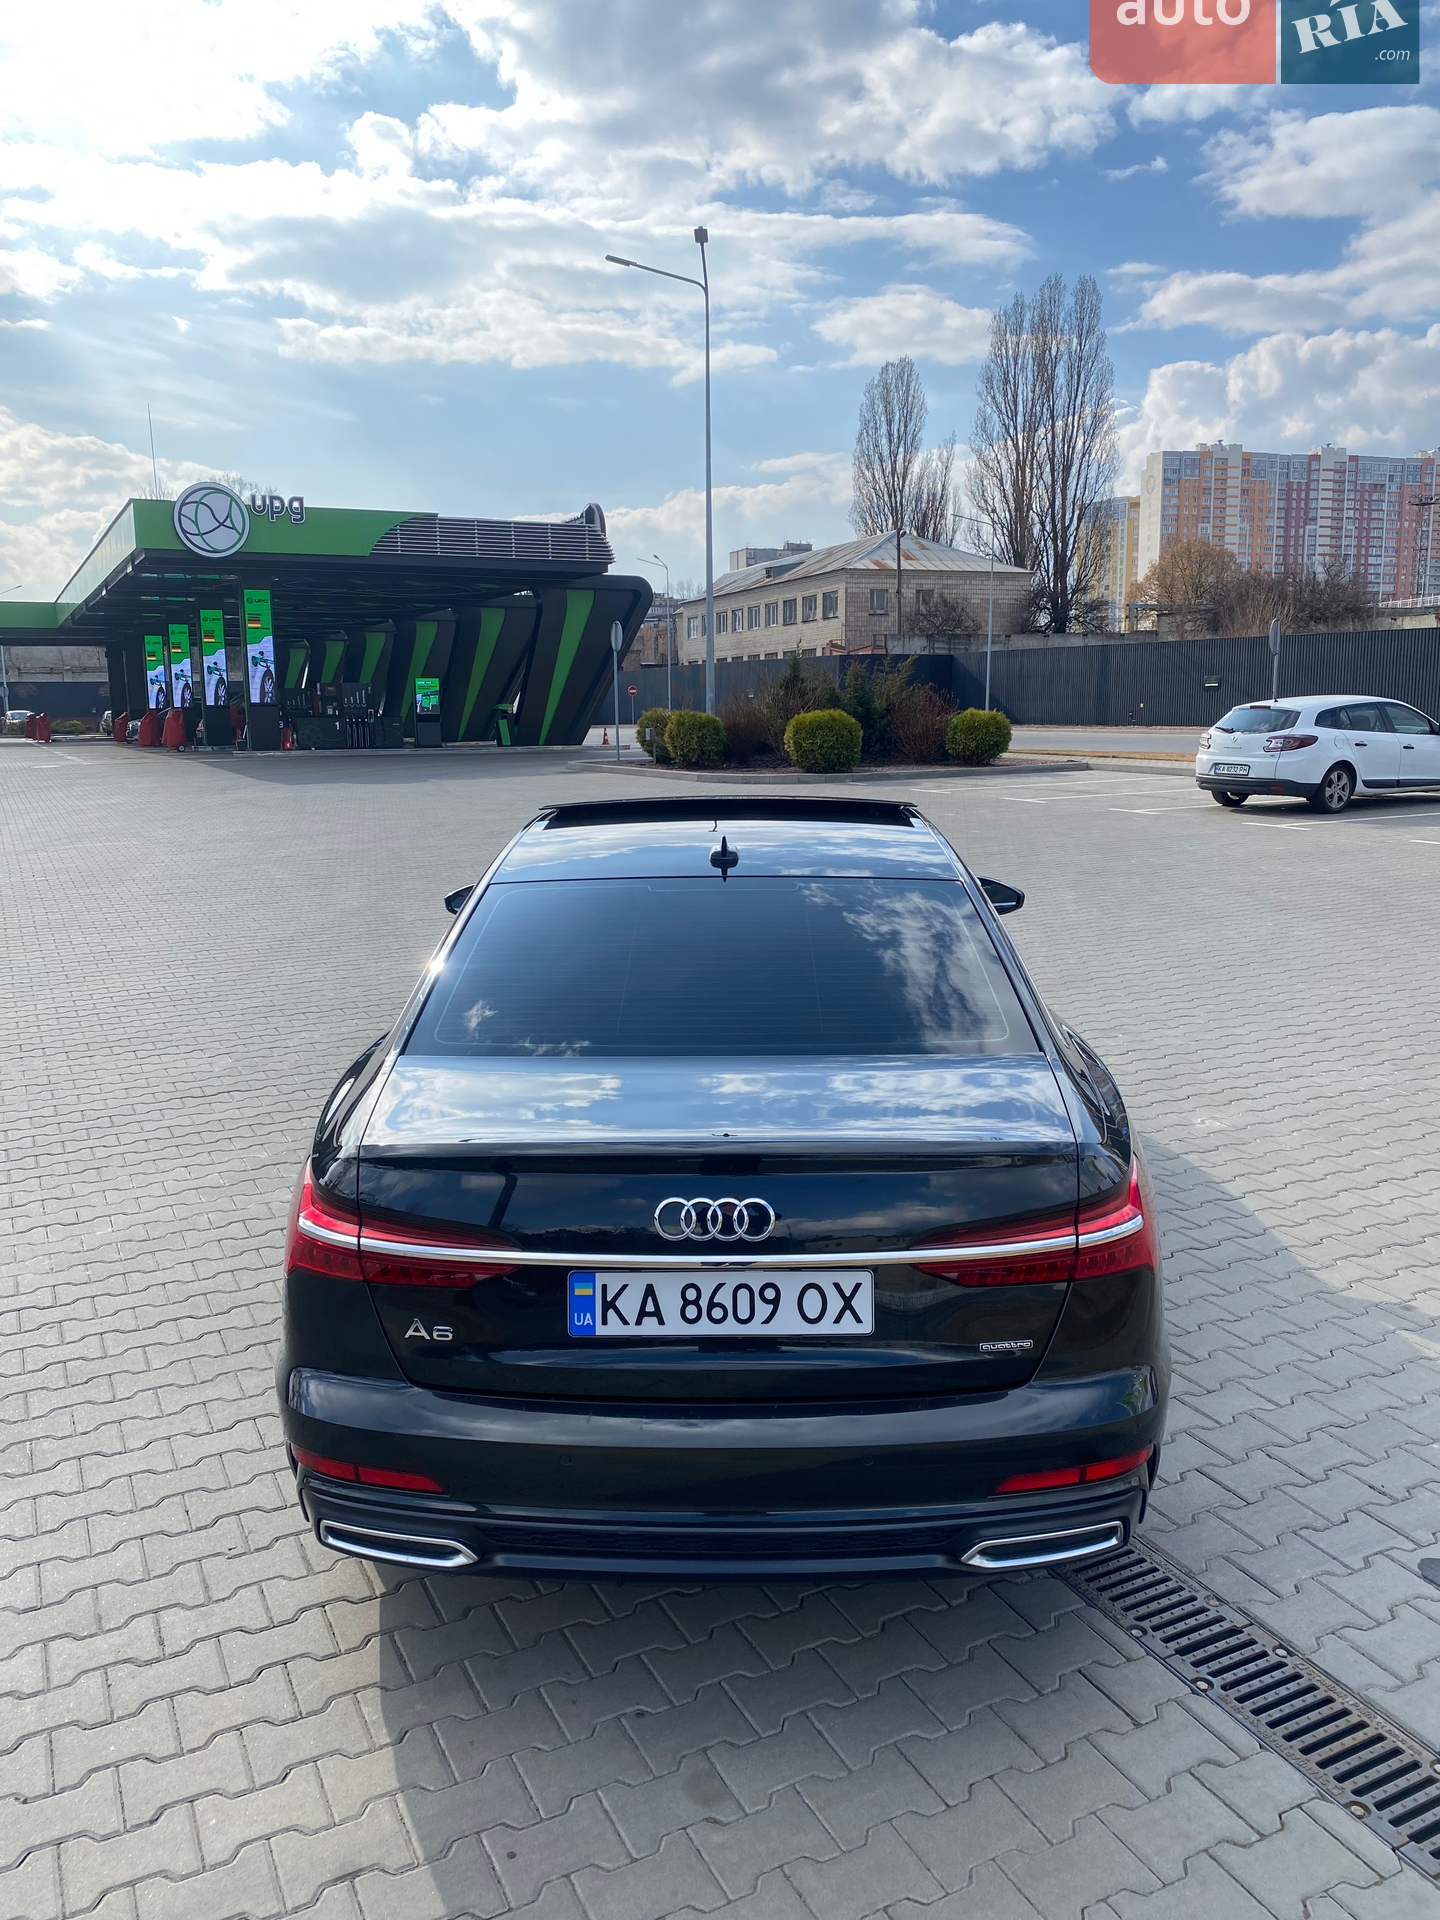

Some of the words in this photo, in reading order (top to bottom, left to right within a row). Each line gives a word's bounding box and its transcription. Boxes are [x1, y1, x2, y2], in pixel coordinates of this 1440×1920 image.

[249, 493, 306, 524] upg
[600, 1283, 666, 1326] KA
[679, 1282, 782, 1325] 8609
[796, 1282, 864, 1325] OX
[404, 1317, 454, 1341] A6
[574, 1312, 593, 1326] UA
[983, 1342, 1031, 1351] quattro
